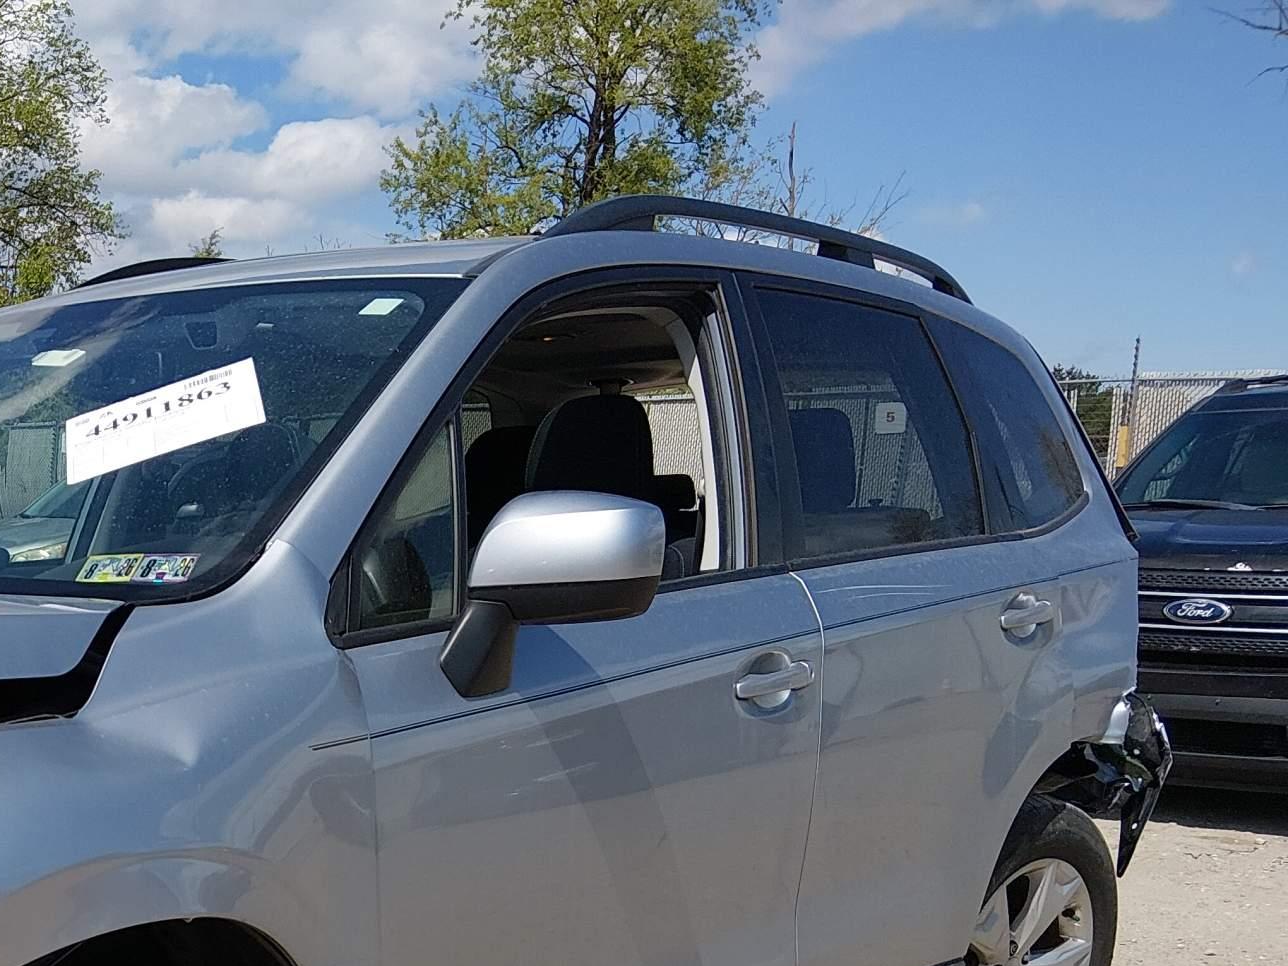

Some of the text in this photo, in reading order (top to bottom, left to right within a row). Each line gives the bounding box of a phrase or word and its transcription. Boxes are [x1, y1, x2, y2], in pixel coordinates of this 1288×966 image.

[86, 382, 231, 436] 44911863
[887, 411, 896, 423] 5
[84, 558, 138, 579] 8 26
[140, 557, 195, 577] 8 26
[1176, 602, 1215, 617] Ford
